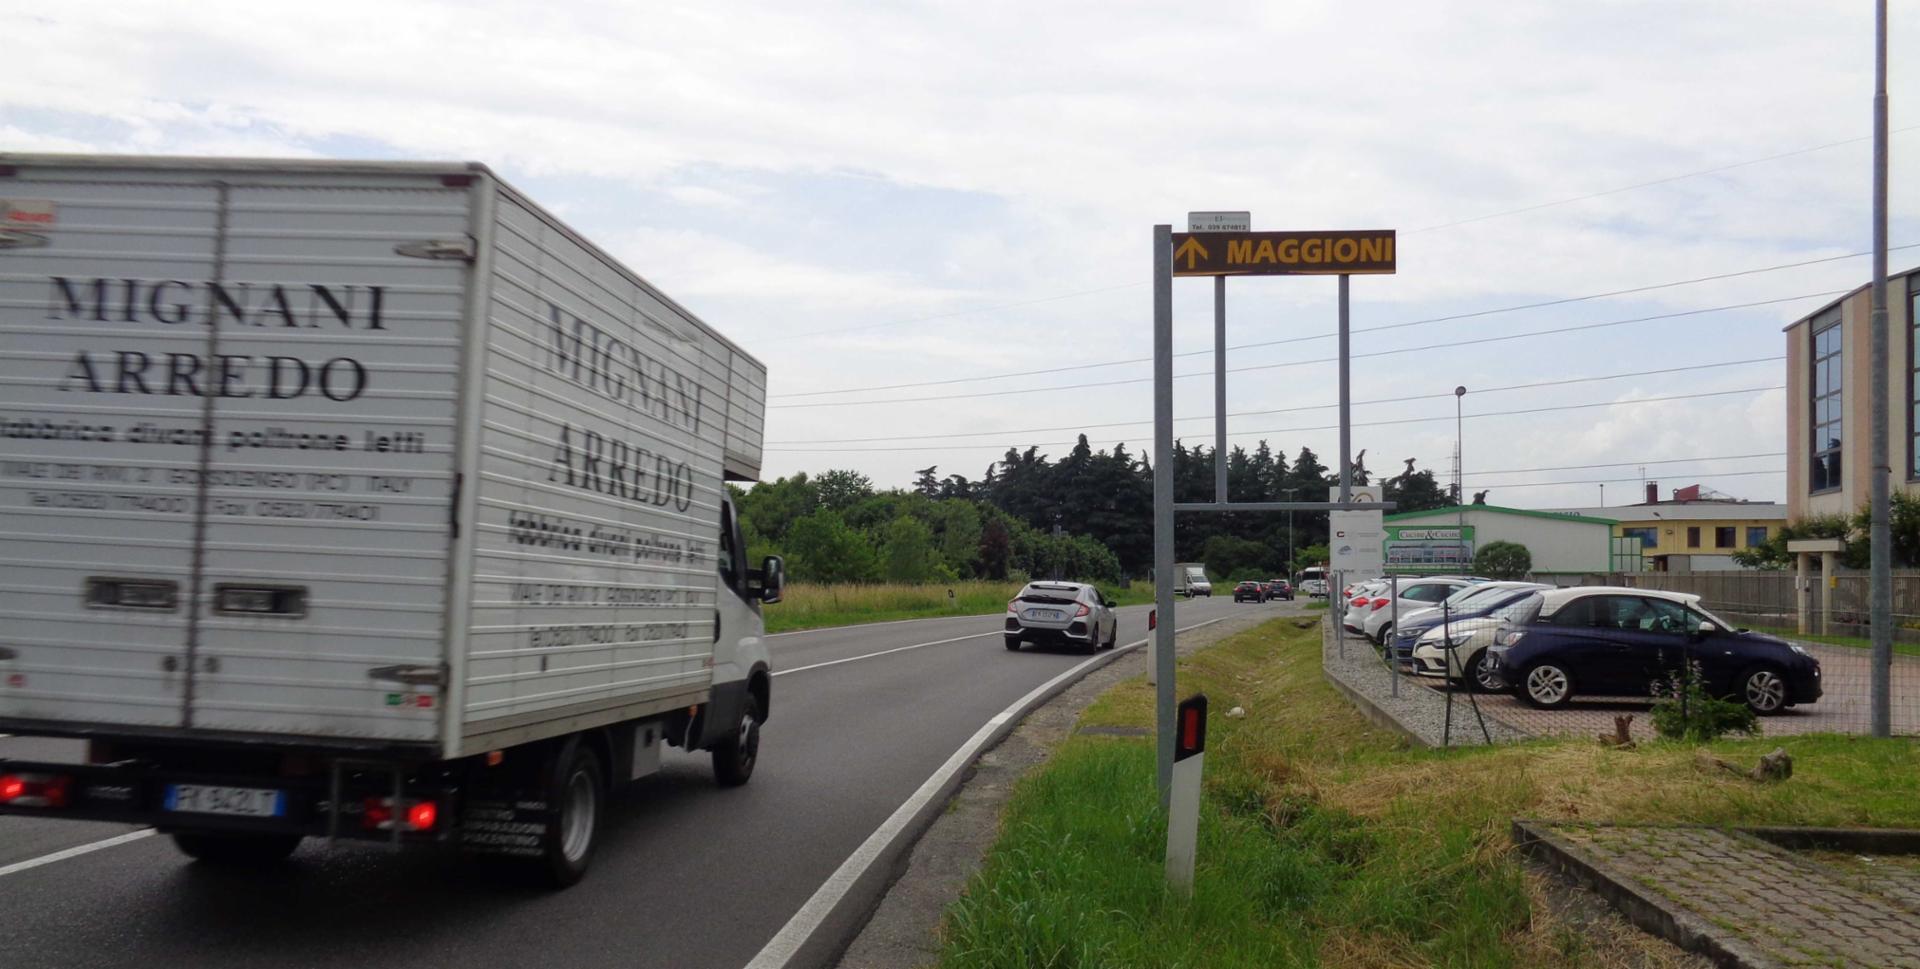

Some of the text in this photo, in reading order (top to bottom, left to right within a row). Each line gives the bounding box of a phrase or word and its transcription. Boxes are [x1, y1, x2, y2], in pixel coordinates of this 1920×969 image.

[1226, 237, 1393, 264] MAGGIONI
[46, 276, 390, 331] MIGNANI
[58, 349, 368, 402] ARREDO
[546, 303, 701, 434] MIGNANI
[227, 426, 349, 452] poltrone
[363, 429, 425, 454] letti
[547, 421, 694, 513] ARREDO
